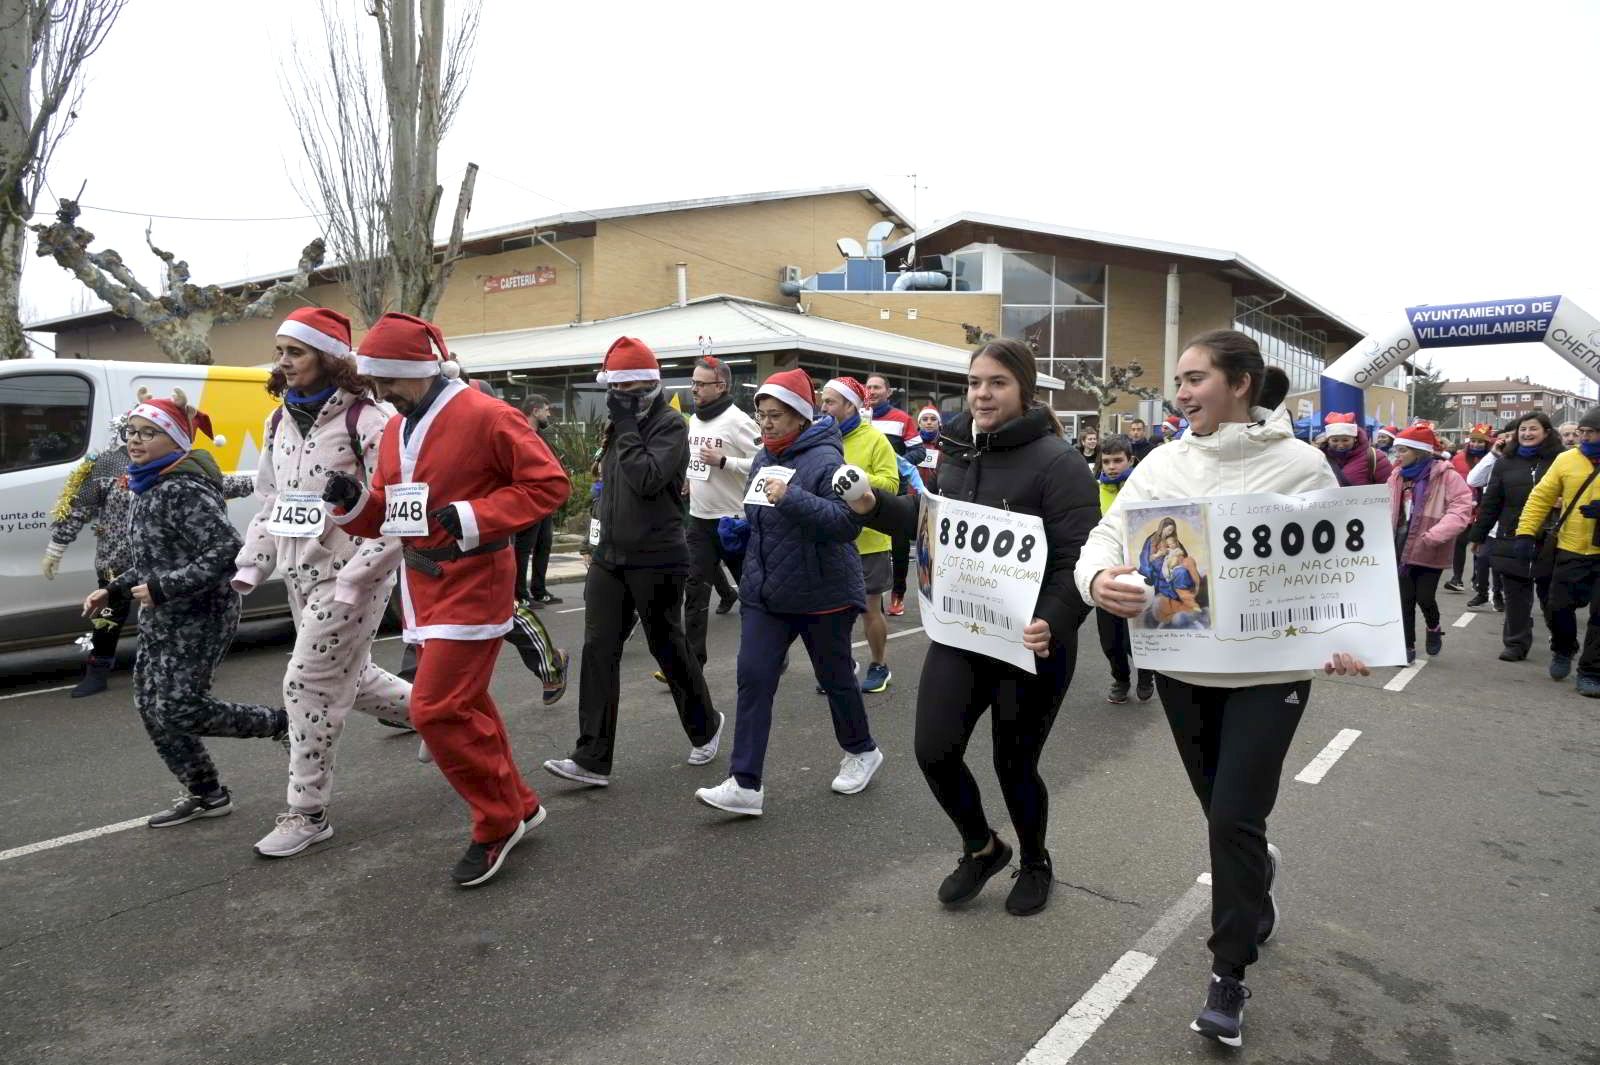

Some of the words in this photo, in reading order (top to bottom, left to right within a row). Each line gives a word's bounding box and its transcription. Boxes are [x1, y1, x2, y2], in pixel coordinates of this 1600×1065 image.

[500, 273, 536, 290] CAFETERIA
[1413, 303, 1525, 322] AYUNTAMIENTO
[1532, 301, 1552, 313] DE
[1417, 318, 1547, 340] VILLAQUILAMBRE
[32, 510, 46, 519] de
[273, 506, 321, 525] 1450
[386, 501, 423, 522] 1448
[8, 524, 15, 533] y
[18, 521, 47, 530] León
[940, 517, 1035, 562] 88008
[1223, 518, 1364, 560] 88008
[936, 566, 947, 578] DE
[958, 572, 997, 589] NAVIDAD
[943, 554, 984, 572] LOTERIA
[991, 563, 1040, 584] NACIONAL
[1218, 562, 1286, 580] LOTERIA
[1301, 555, 1380, 571] NACIONAL
[1249, 580, 1266, 593] DE
[1284, 572, 1355, 588] NAVIDAD
